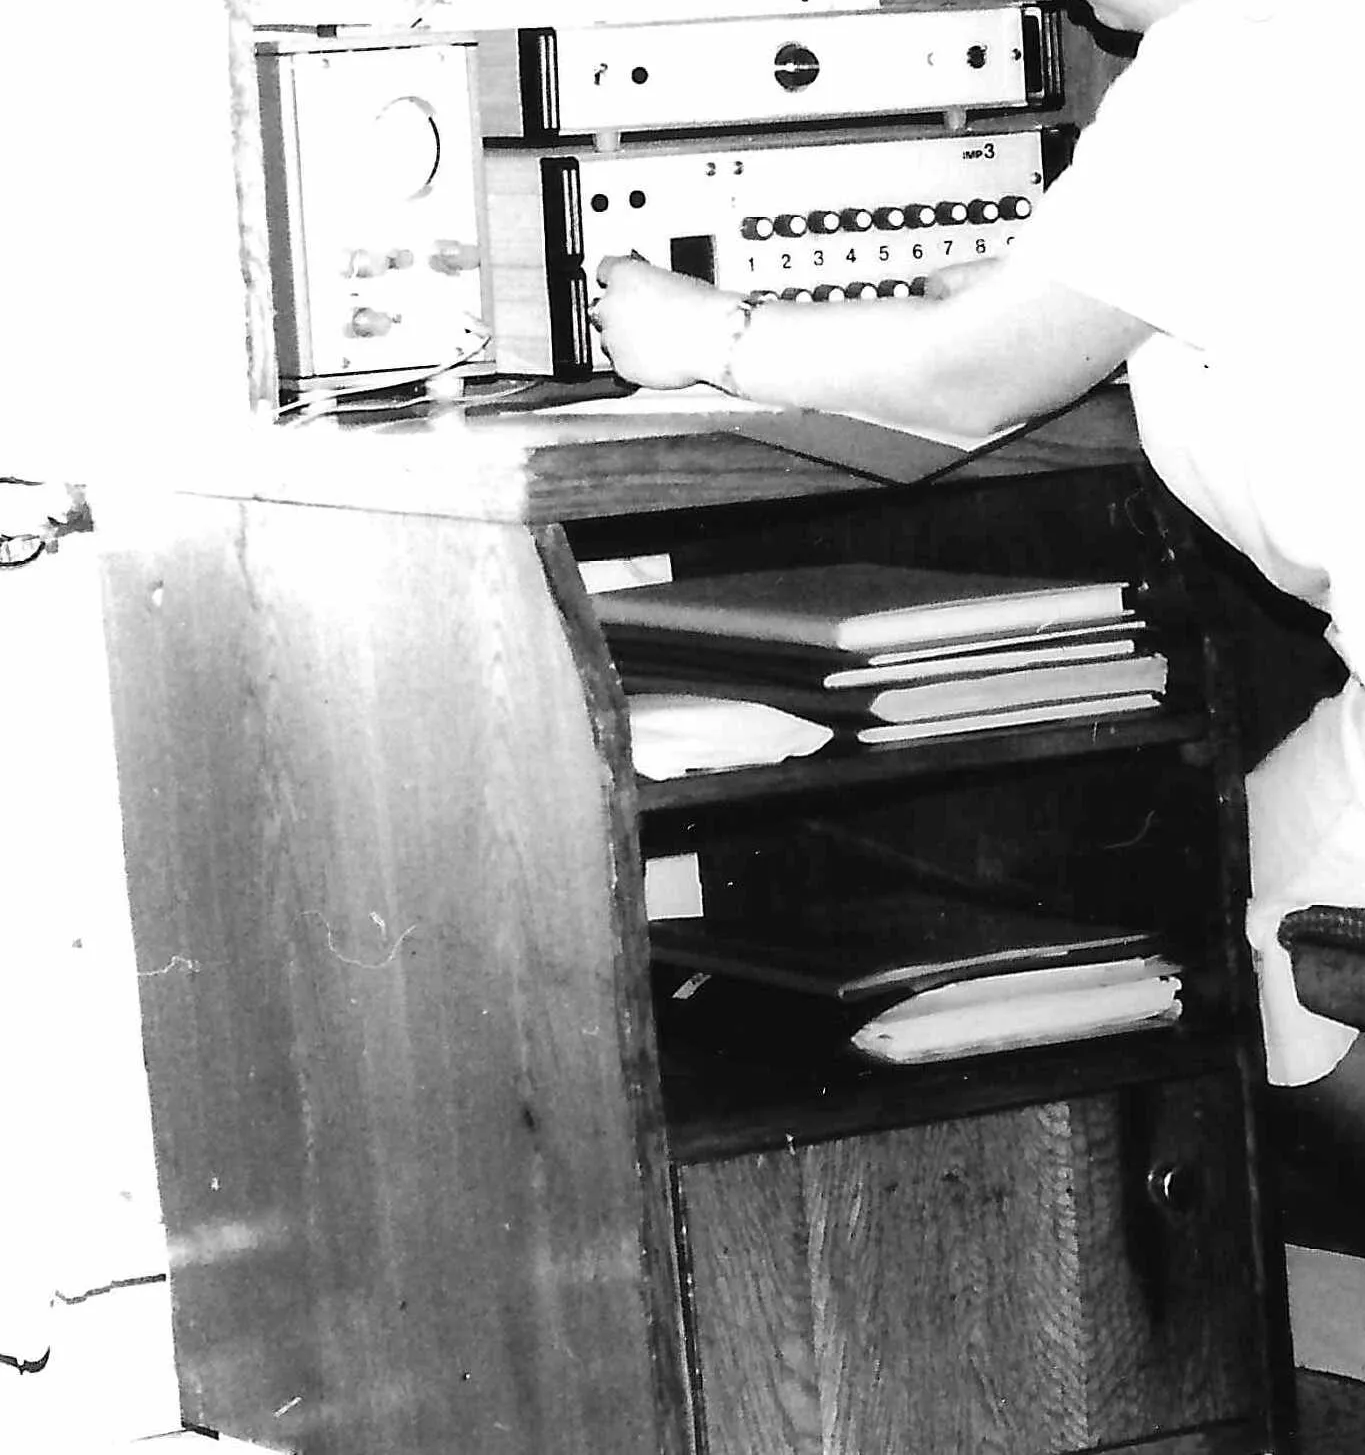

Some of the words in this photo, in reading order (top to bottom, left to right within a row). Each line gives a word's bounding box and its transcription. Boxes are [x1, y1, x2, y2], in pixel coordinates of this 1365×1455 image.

[781, 254, 791, 269] 2
[813, 250, 824, 266] 3
[845, 248, 857, 263] 4
[879, 245, 890, 261] 5
[912, 243, 923, 259] 6
[943, 240, 953, 256] 7
[975, 238, 986, 254] 8
